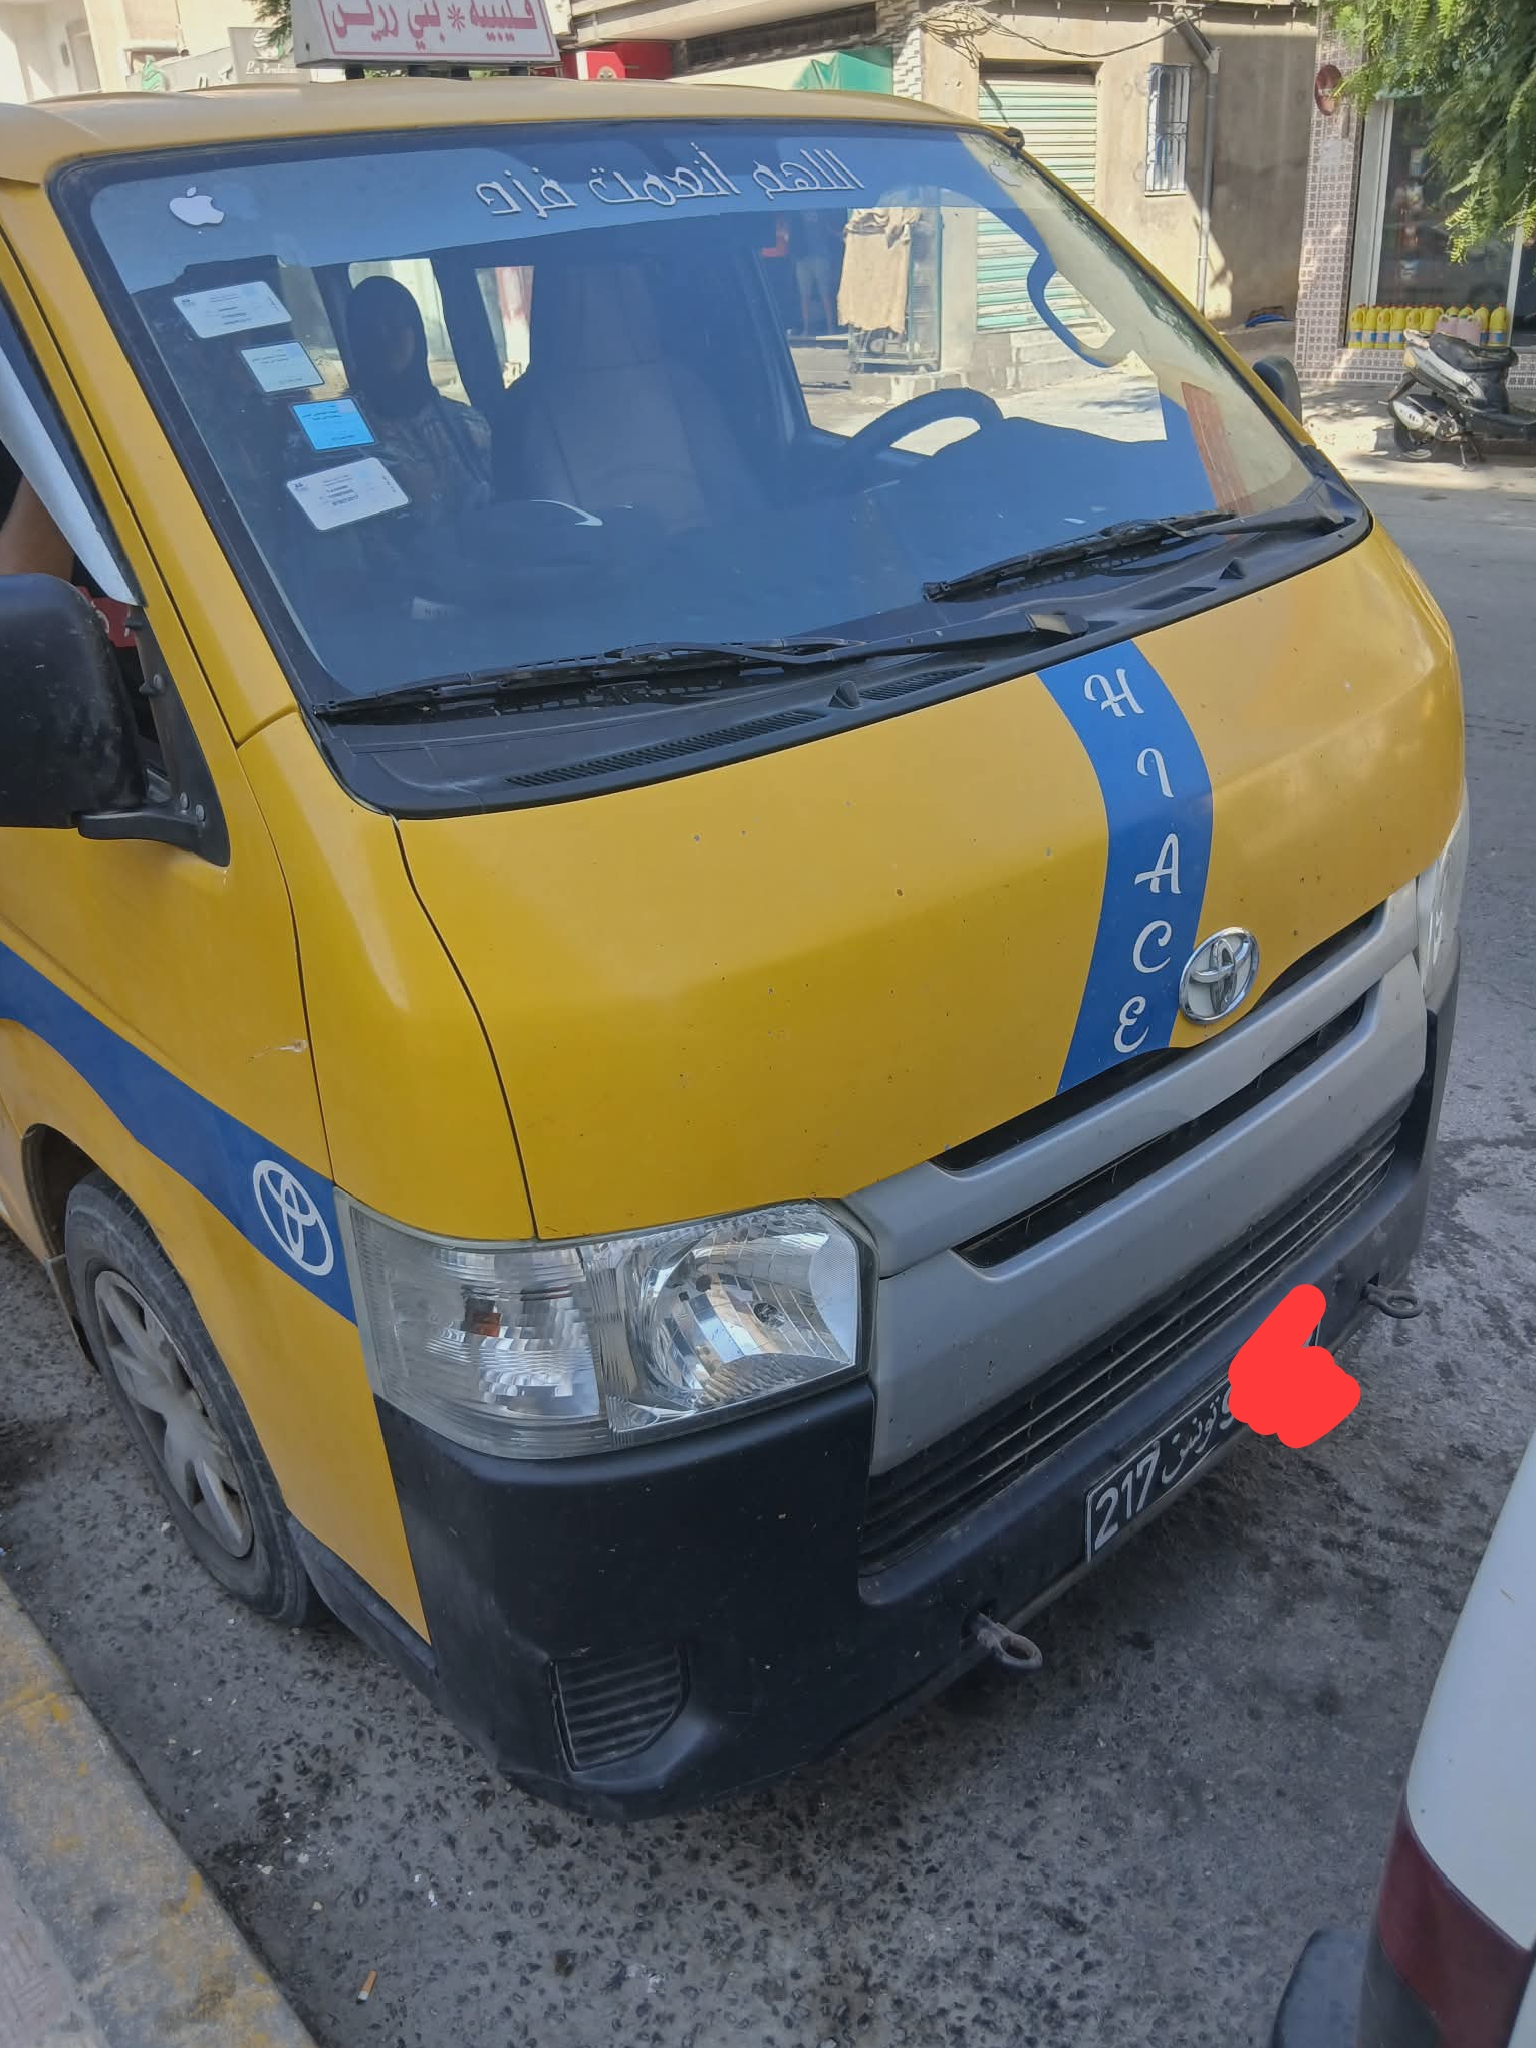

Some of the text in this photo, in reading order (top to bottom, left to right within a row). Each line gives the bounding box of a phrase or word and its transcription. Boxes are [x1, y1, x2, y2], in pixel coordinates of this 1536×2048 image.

[752, 148, 866, 200] اللهم
[1083, 668, 1181, 1054] HIACE
[1094, 1440, 1161, 1551] 217
[1161, 1395, 1220, 1484] تونس
